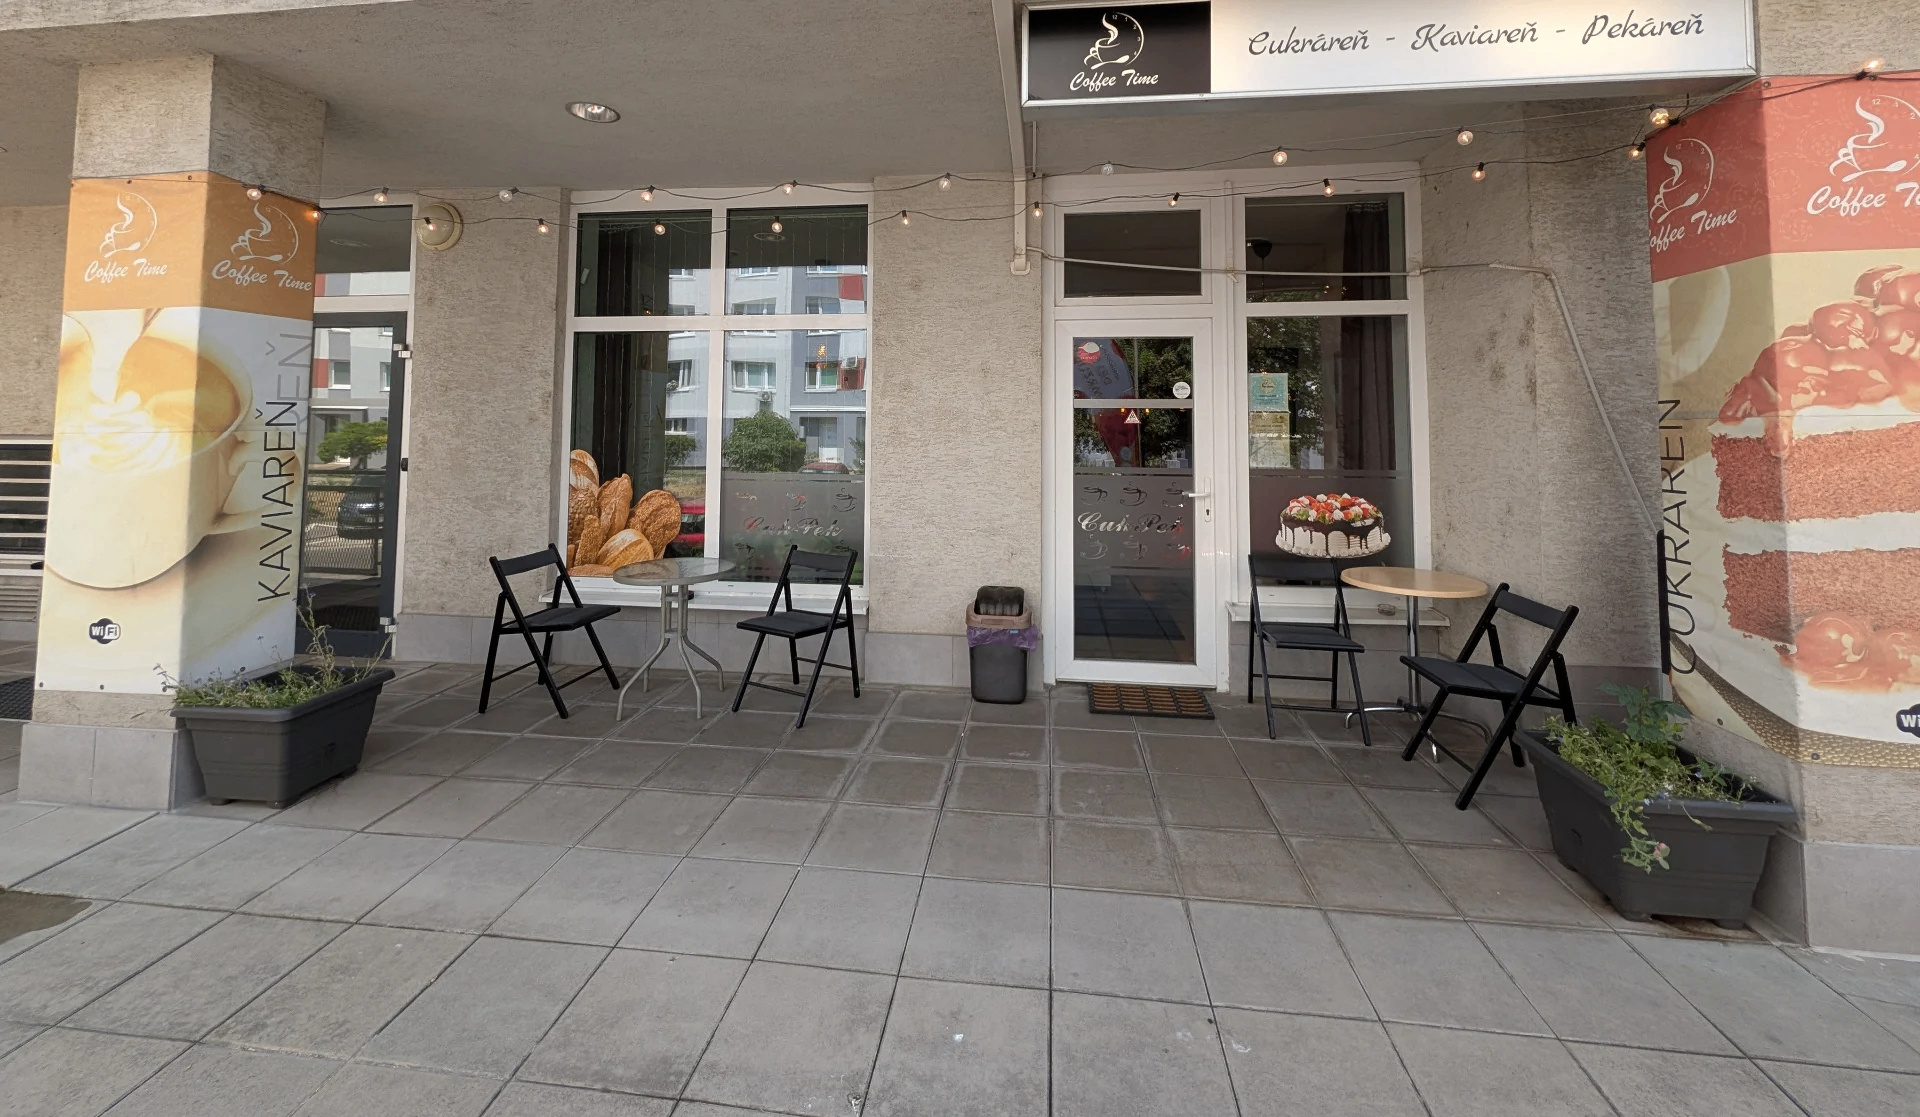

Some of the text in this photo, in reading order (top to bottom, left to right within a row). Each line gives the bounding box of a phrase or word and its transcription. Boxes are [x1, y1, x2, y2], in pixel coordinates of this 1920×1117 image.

[1248, 26, 1370, 56] Cukráreň
[1410, 21, 1539, 53] Kaviareň
[1581, 9, 1705, 45] Pekáreň
[1069, 68, 1159, 92] Coffee Time
[1806, 185, 1887, 217] Coffee
[1648, 209, 1738, 253] offee Time
[84, 257, 168, 284] Coffee Time
[211, 259, 312, 291] Coffee Time
[255, 401, 298, 601] KAVIAREŇ
